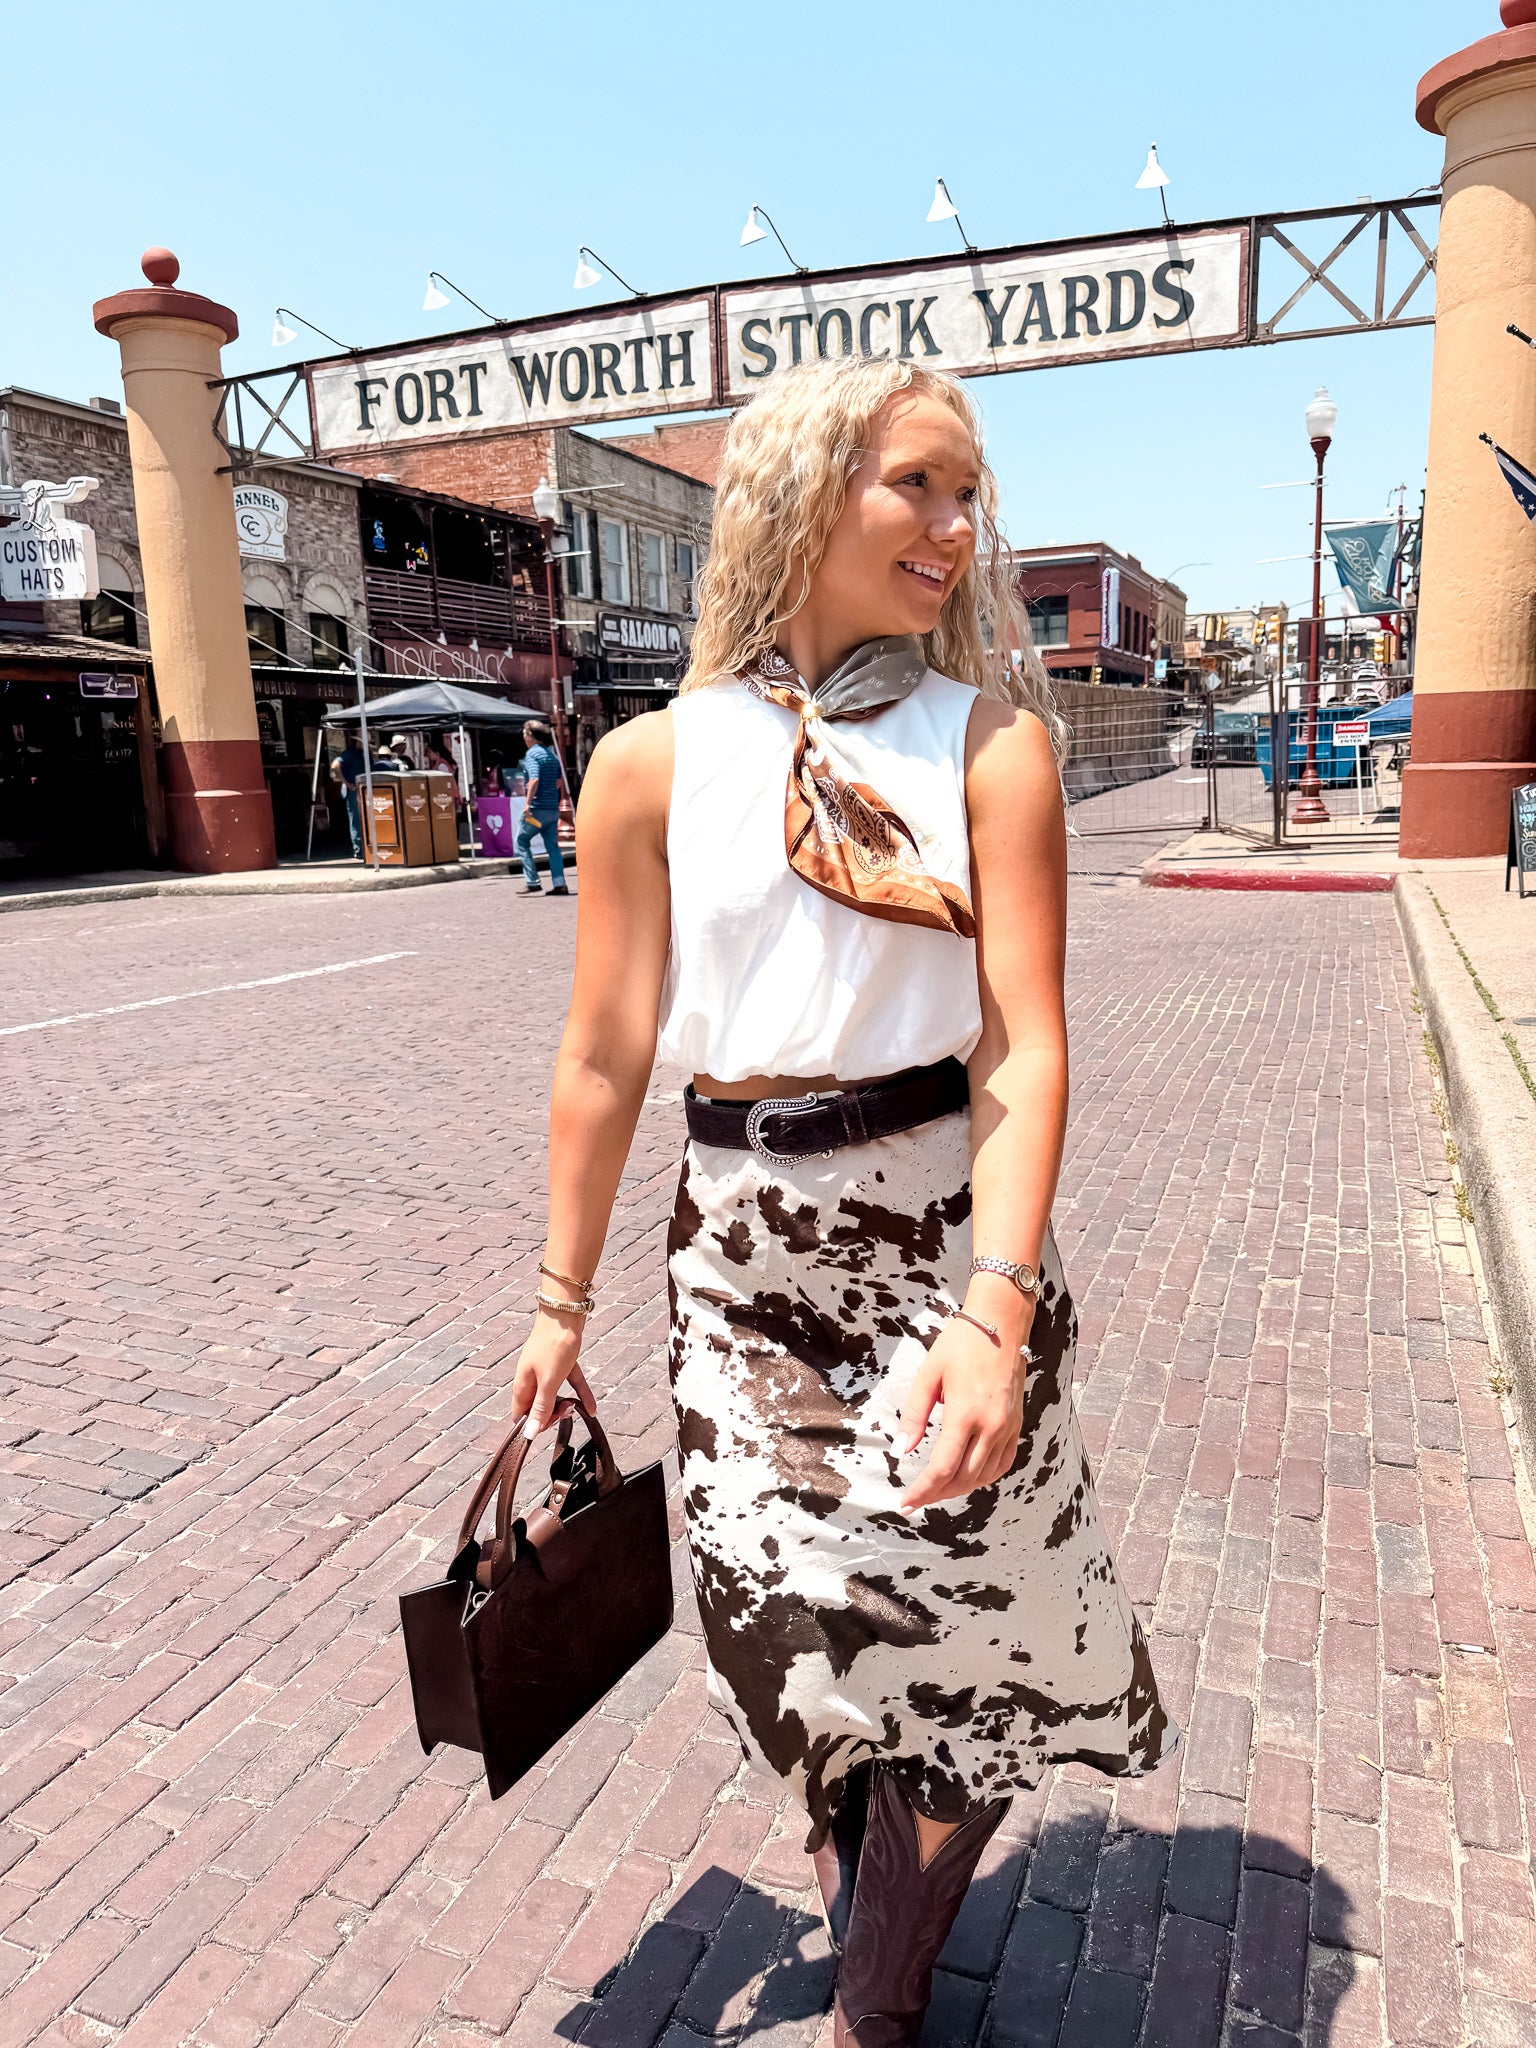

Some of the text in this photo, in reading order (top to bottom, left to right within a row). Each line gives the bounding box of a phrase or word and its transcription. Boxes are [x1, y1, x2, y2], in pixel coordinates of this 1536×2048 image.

[354, 258, 1195, 431] FORT WORTH STOCK YARDS
[3, 538, 78, 564] CUSTOM
[20, 567, 64, 591] HATS
[620, 618, 668, 650] SALOON
[393, 647, 511, 684] LOVE SHACK
[317, 683, 344, 698] FIRST
[1338, 723, 1366, 731] DANGER
